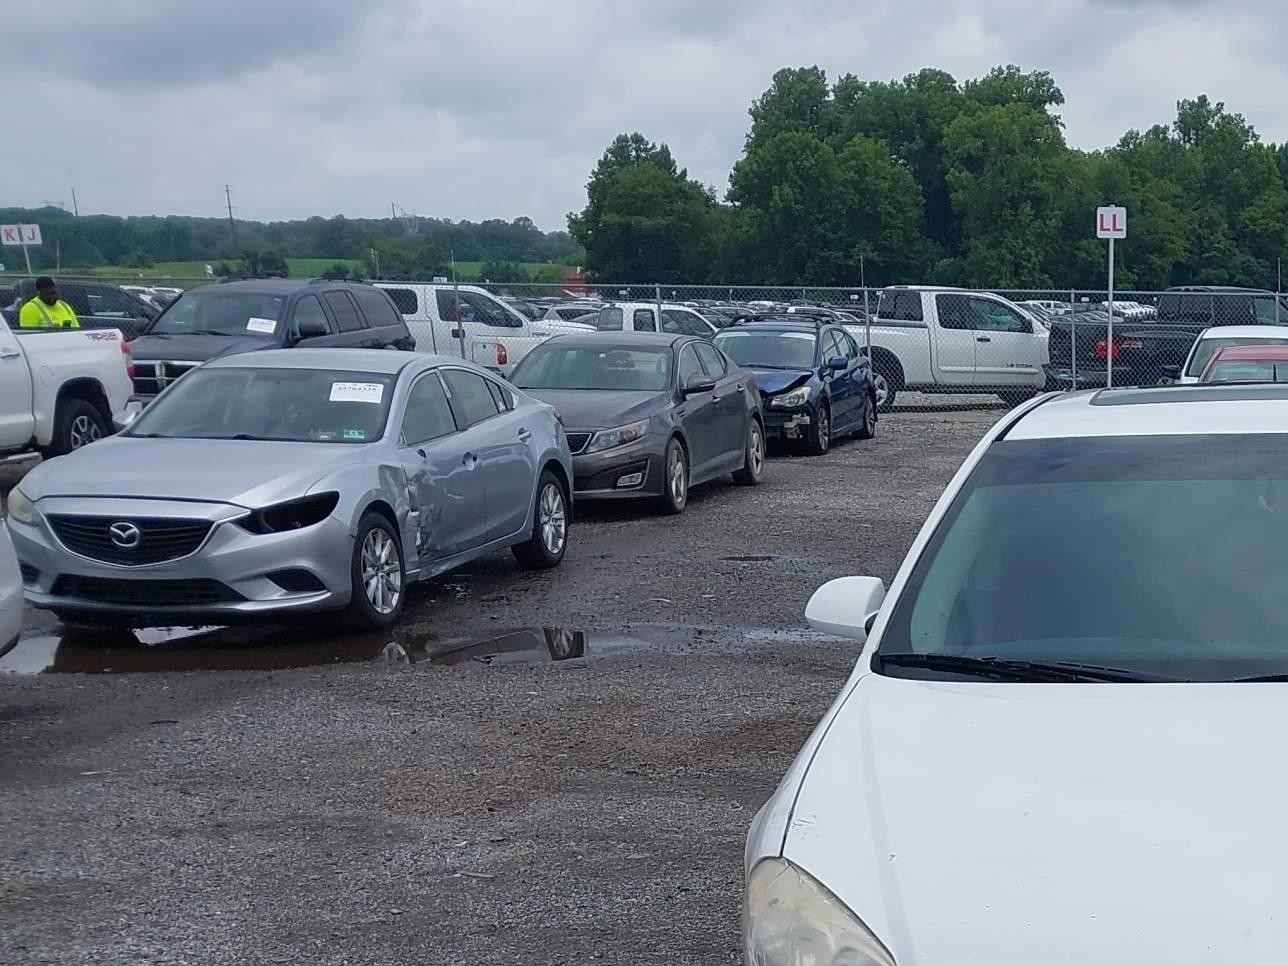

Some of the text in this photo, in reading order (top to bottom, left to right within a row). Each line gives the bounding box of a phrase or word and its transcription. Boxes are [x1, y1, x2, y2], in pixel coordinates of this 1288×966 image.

[1100, 213, 1124, 232] LL
[4, 227, 36, 241] K J
